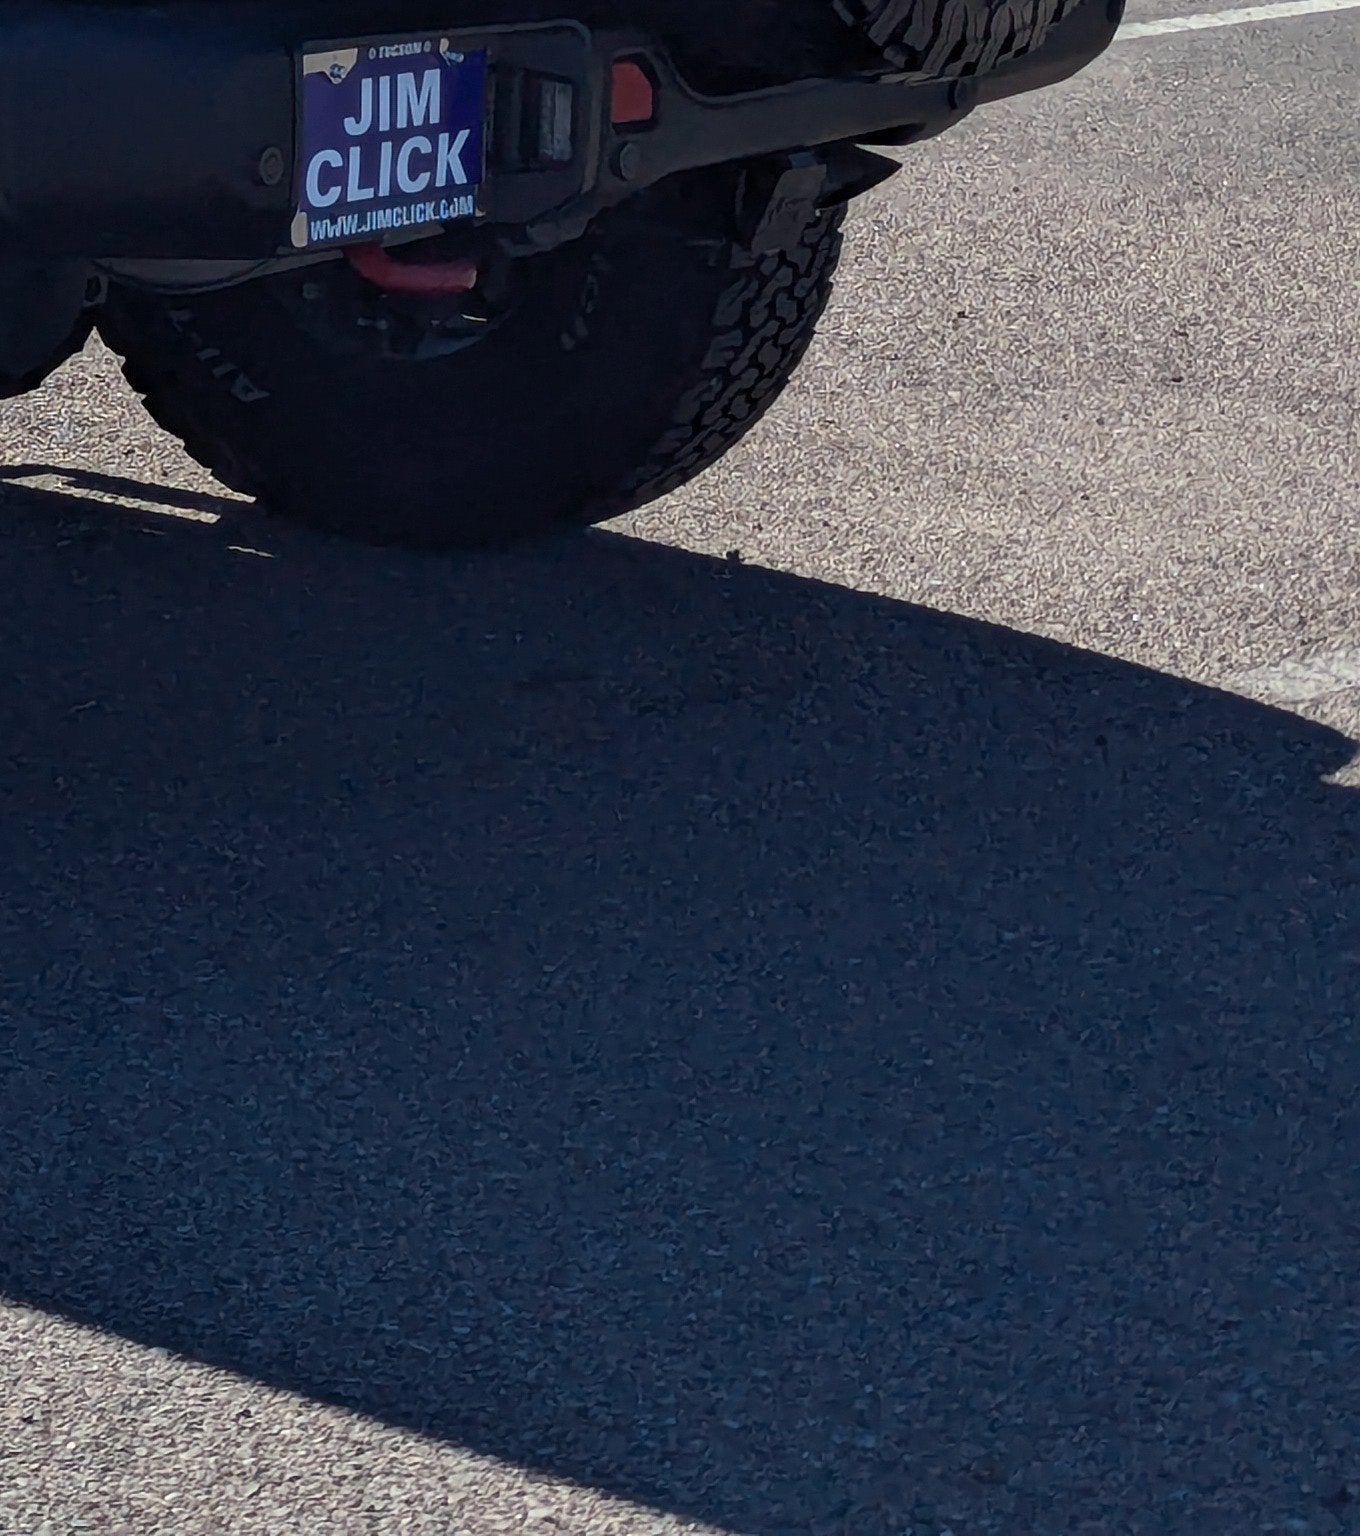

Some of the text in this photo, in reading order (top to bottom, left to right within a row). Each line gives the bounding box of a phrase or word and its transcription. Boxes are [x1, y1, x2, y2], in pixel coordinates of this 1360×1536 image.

[344, 68, 442, 135] JIM
[305, 129, 470, 207] CLICK
[312, 195, 473, 241] WWW.JIMCLICK.COM
